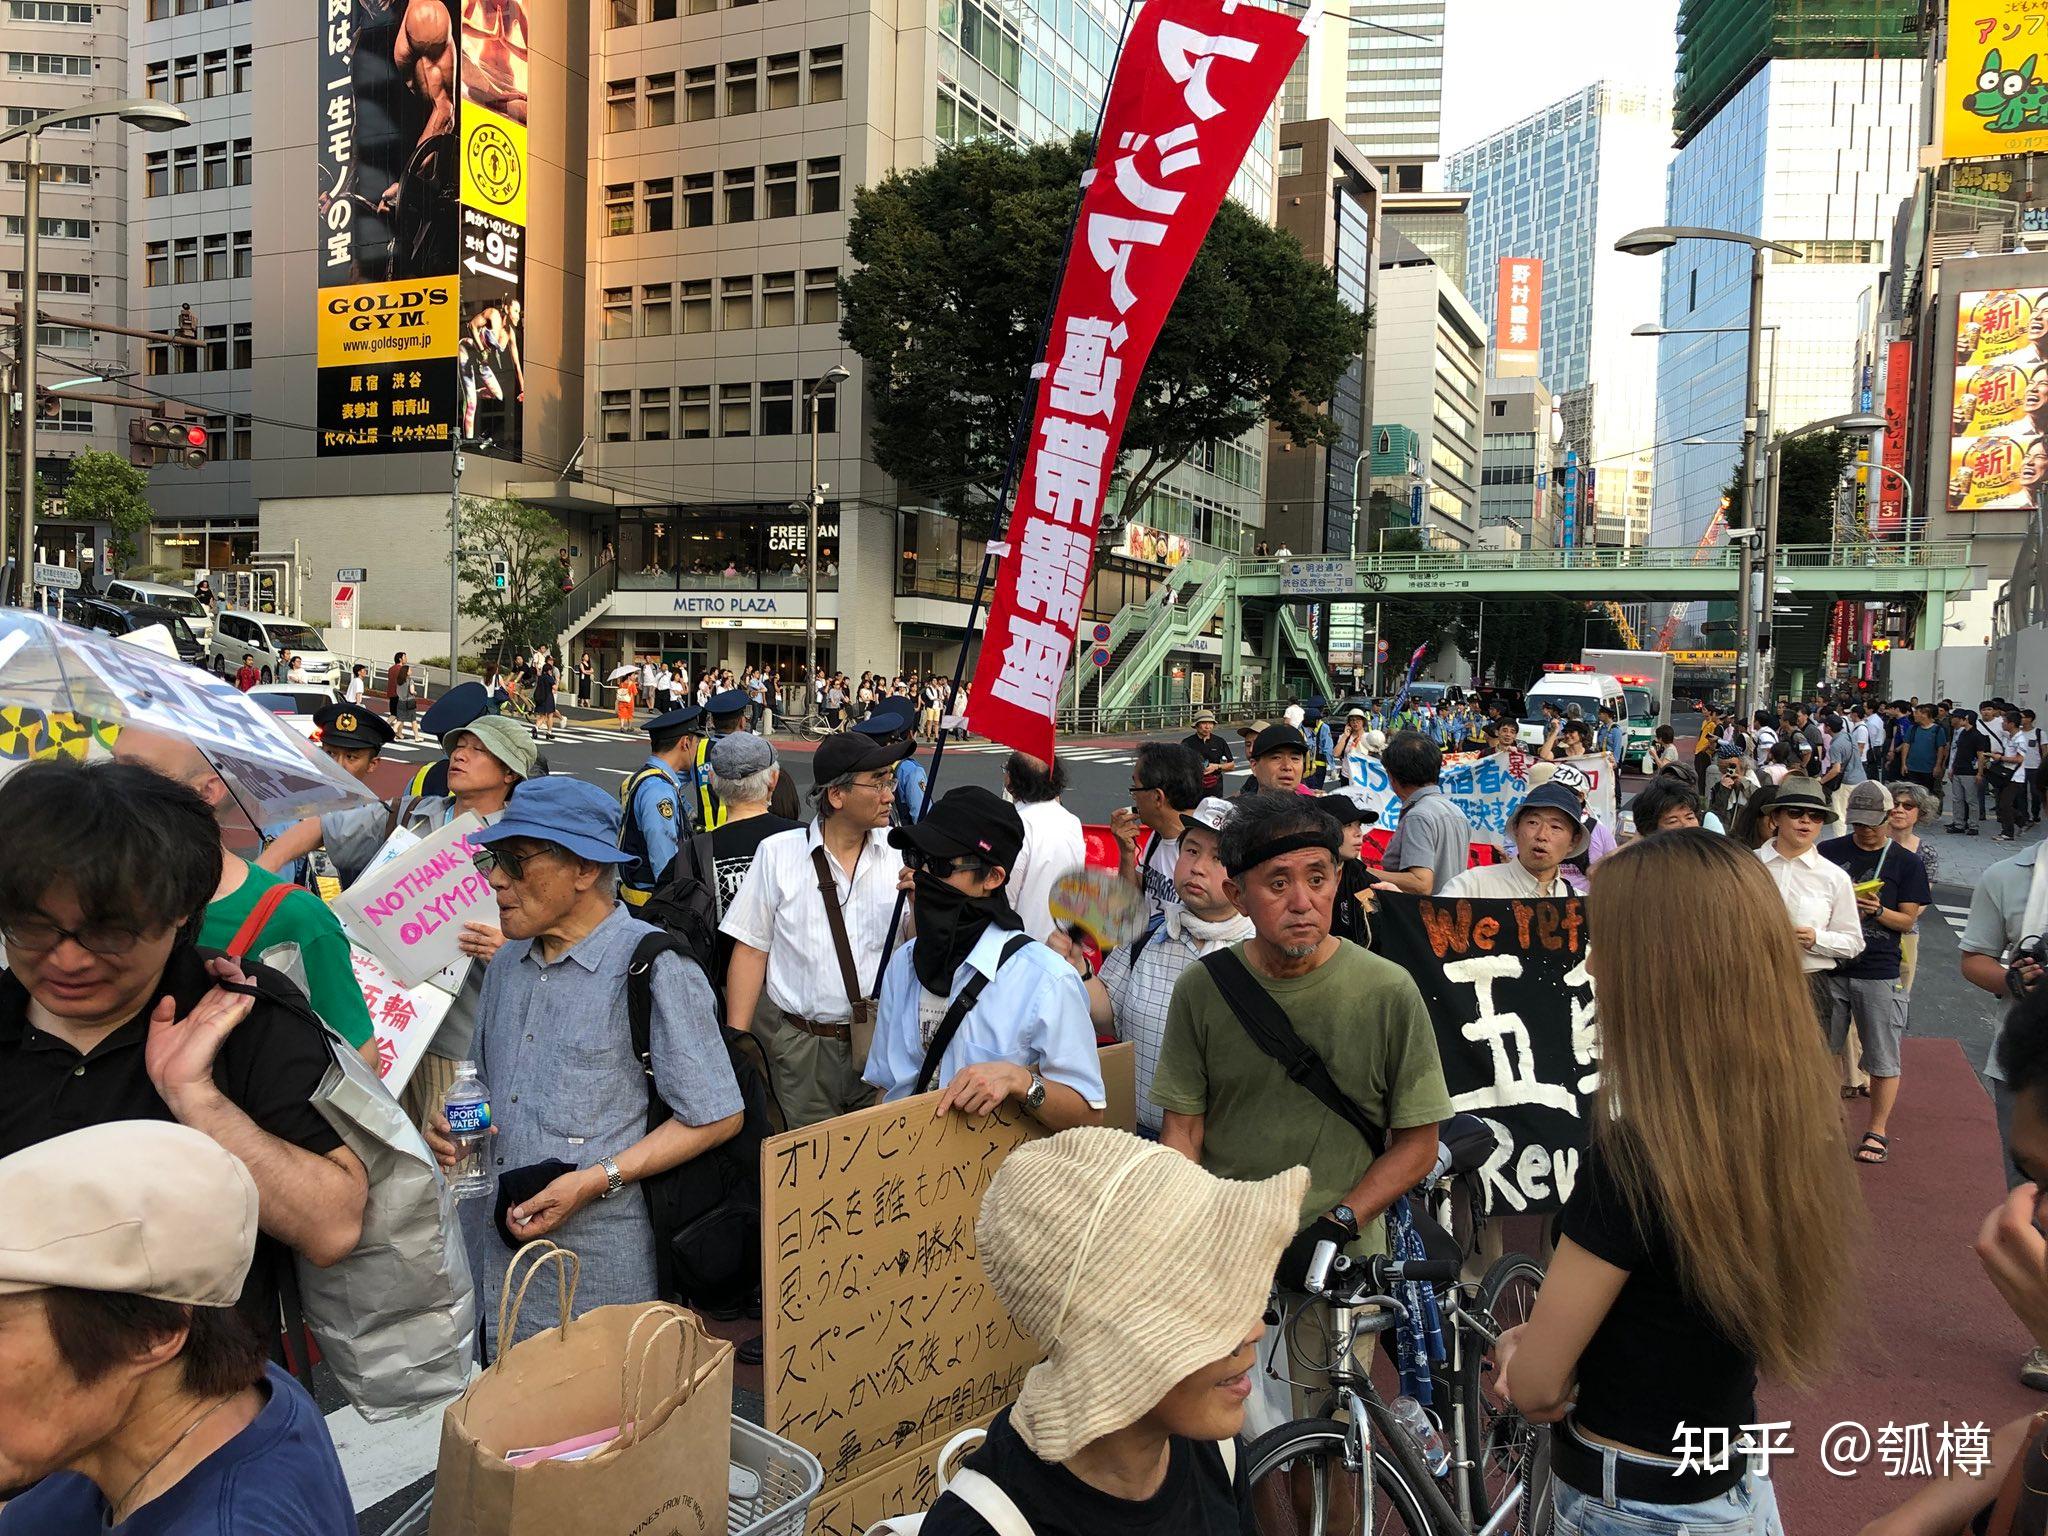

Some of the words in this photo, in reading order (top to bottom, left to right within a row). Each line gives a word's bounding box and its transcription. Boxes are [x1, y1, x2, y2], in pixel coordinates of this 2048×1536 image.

[1975, 15, 2048, 44] アンフ
[477, 173, 513, 198] GYM
[486, 232, 518, 269] 9F
[328, 288, 449, 314] GOLD'S
[349, 310, 426, 331] GYM
[343, 333, 432, 352] www.goldsgym.jp
[350, 375, 379, 392] 原宿
[392, 371, 422, 389] 渋谷
[342, 403, 379, 420] 表参道
[392, 398, 430, 416] 南青山
[770, 524, 838, 538] FREEAN
[769, 538, 806, 551] CAFE
[1305, 563, 1343, 573] 明治通り
[1282, 577, 1353, 588] 渋谷区渋谷一丁目
[674, 597, 725, 612] METRO
[730, 598, 777, 613] PLAZA
[400, 870, 491, 945] OLYMPI
[1419, 900, 1500, 958] We
[1511, 899, 1584, 953] ref
[449, 1108, 483, 1120] SPORTS
[449, 1118, 480, 1129] WATER
[1478, 1116, 1579, 1216] Rev
[777, 1132, 1032, 1264] 日本を誰もが応
[776, 1275, 998, 1395] スポーツマンシッ
[661, 1495, 681, 1514] FROM
[681, 1494, 694, 1508] THE
[692, 1500, 706, 1532] WORLD
